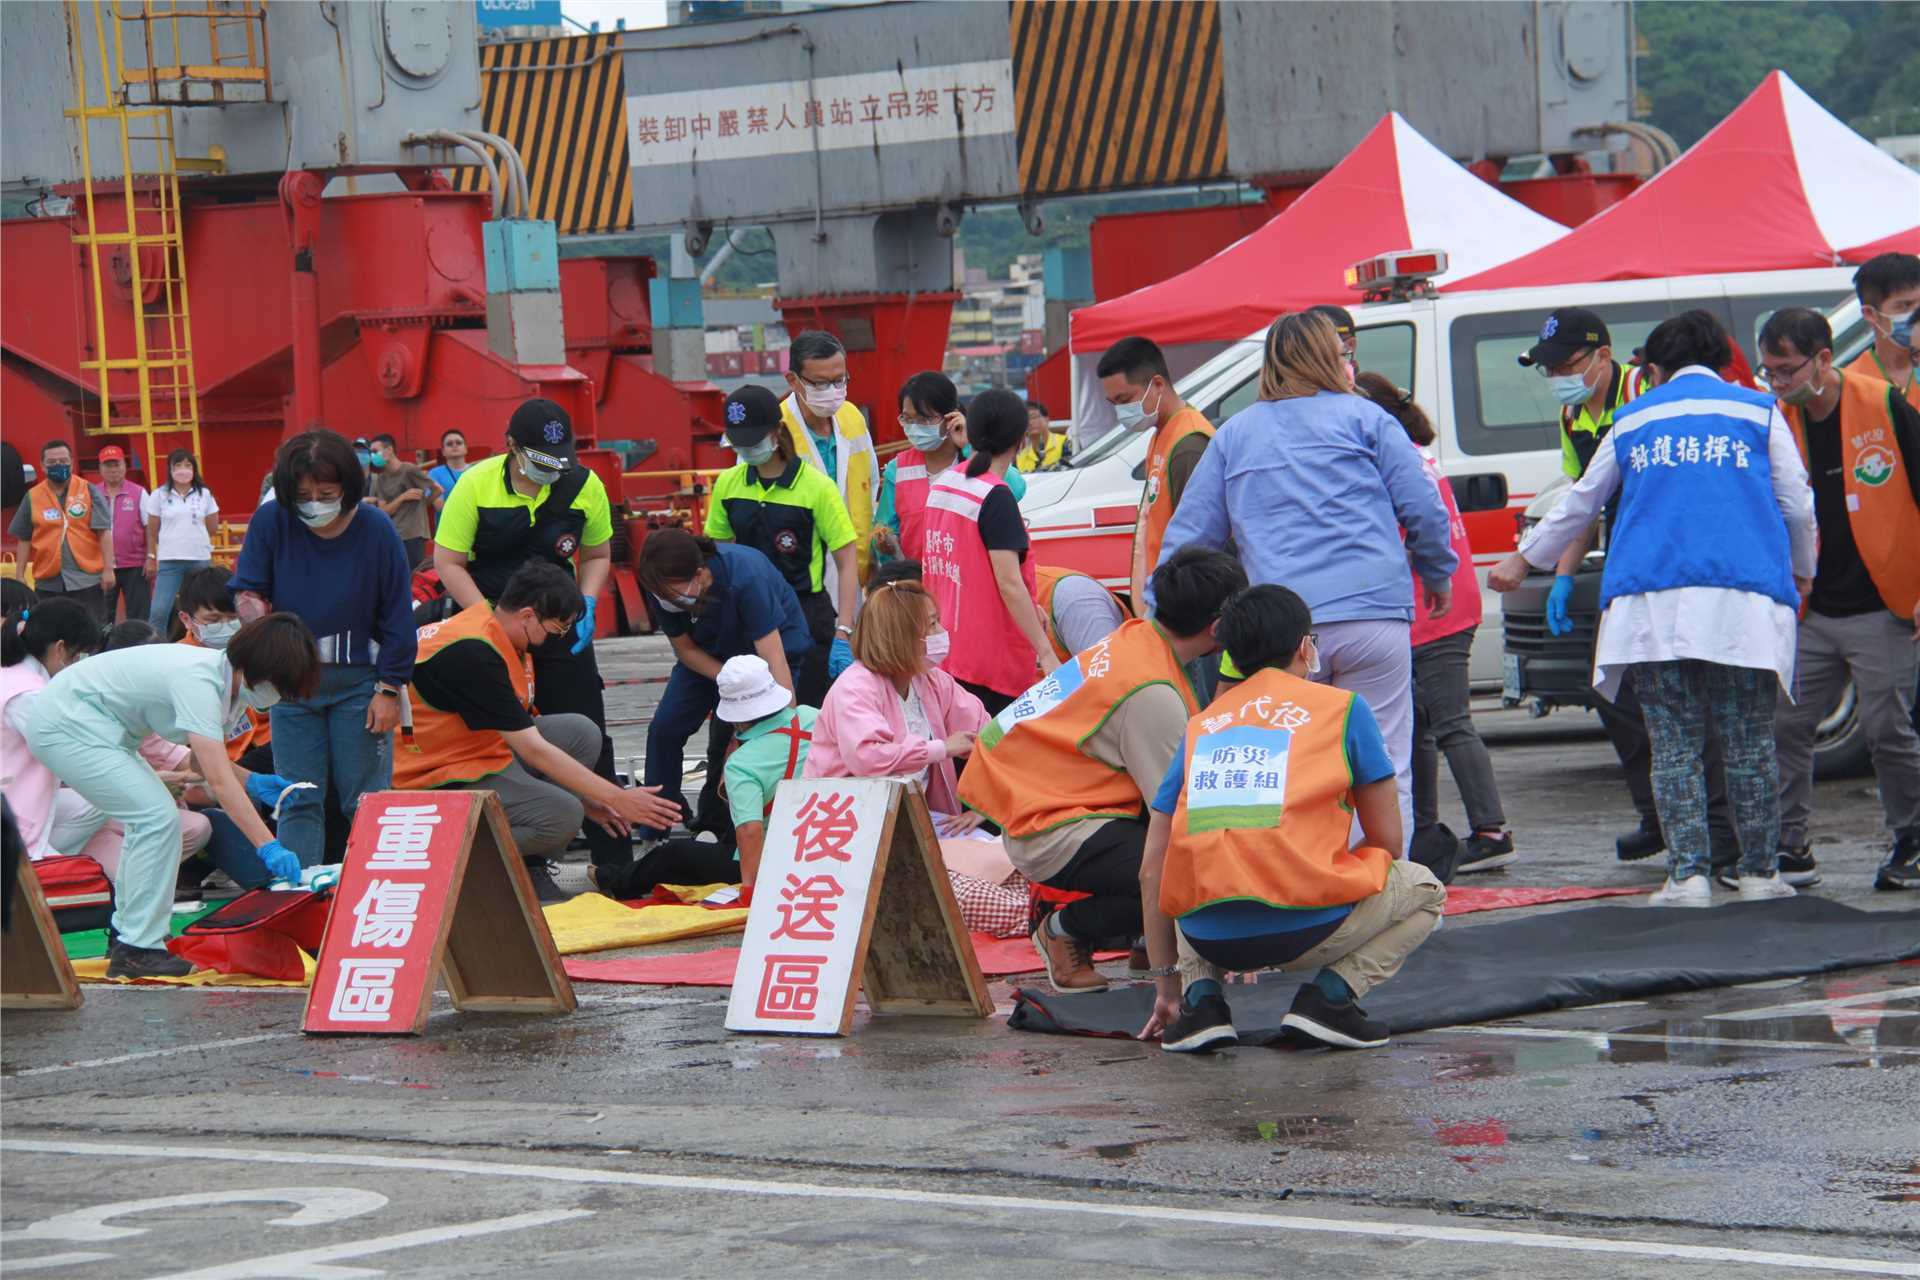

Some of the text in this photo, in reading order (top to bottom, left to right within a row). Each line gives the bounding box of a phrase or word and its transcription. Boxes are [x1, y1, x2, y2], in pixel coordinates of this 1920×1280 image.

[638, 83, 996, 145] 裝卸中嚴禁人員站立吊架下方
[1629, 434, 1752, 473] 救護指揮官
[1193, 769, 1280, 790] 救護組
[1211, 745, 1270, 767] 防災
[328, 804, 442, 1022] 重傷區
[755, 792, 859, 1021] 後送區
